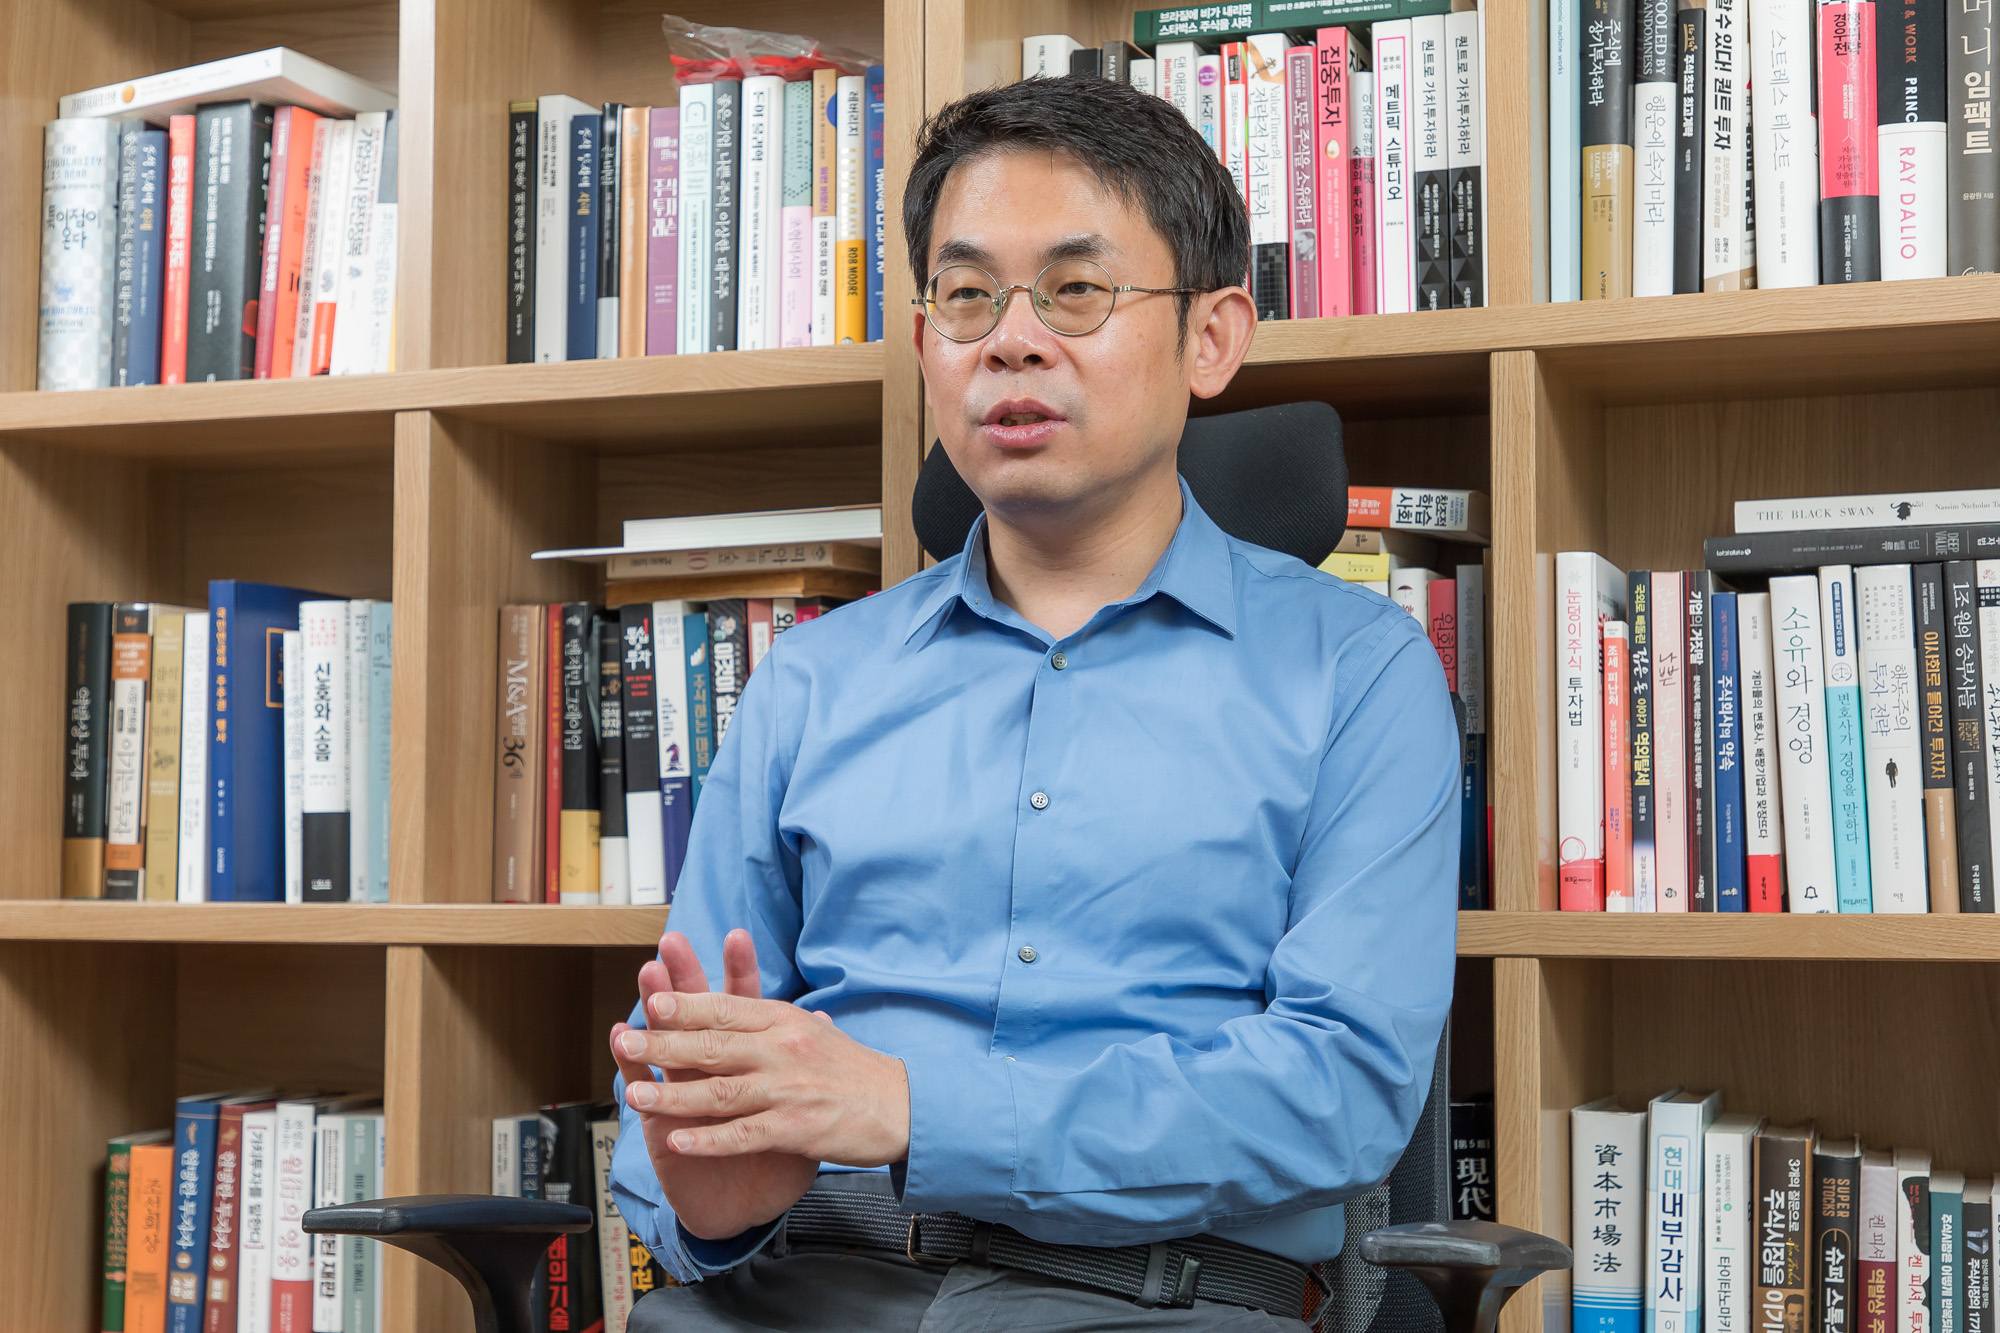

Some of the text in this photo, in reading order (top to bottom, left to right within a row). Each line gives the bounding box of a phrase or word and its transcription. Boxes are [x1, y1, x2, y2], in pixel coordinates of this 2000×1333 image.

[1158, 3, 1253, 24] 브라질에 비가 내리면
[1158, 16, 1253, 36] 스타벅스 주식을 사라
[1557, 24, 1565, 75] machine works
[1587, 19, 1605, 107] 장기투자하라
[1603, 19, 1622, 66] 주식에
[1655, 58, 1666, 76] BY
[1320, 45, 1342, 127] 집중투자
[1422, 39, 1438, 159] 퀀트로 가치투자하라
[1455, 35, 1471, 155] 퀀트로 가치투자하라
[1683, 54, 1695, 94] 주식초보
[1713, 13, 1732, 151] 수 있다! 퀀트 투자
[1769, 29, 1792, 172] 스트레스 테스트
[1904, 23, 1919, 123] WORK PRINC
[847, 91, 859, 137] 레버리지
[1644, 94, 1666, 149] 행운에
[1962, 70, 1993, 155] 임팩트
[1248, 86, 1272, 219] 전략적 가치 투자
[1292, 100, 1315, 226] 모든 주식을 소유하라
[1385, 84, 1403, 201] 메트릭 스튜디오
[1592, 152, 1601, 188] LONG RUN
[1604, 151, 1613, 180] STOCKS
[653, 178, 678, 198] 주식
[714, 93, 733, 301] 좋은 기업, 나쁜 주식, 이상한 대주주
[1898, 147, 1918, 260] RAY DALIO
[1963, 191, 1995, 201] 윤광원 지음
[48, 204, 102, 229] 특이점이
[62, 228, 88, 251] 온다
[118, 130, 138, 326] 좋은 나쁜 이상한 대주주
[1353, 213, 1364, 237] 일기
[818, 259, 828, 277] 투자
[847, 247, 859, 297] ROB MOORE
[1395, 493, 1413, 524] 사회
[1414, 493, 1433, 526] 학습
[1435, 494, 1448, 527] 창조적
[1756, 506, 1875, 521] THE BLACK SWAN
[1934, 501, 1991, 510] Nassim Nicholas
[1935, 530, 1948, 556] VALUE
[1946, 532, 1959, 553] DEEP
[1888, 584, 1898, 641] HEDGING
[1896, 584, 1906, 640] EXTREME VALUE
[1921, 598, 1930, 625] BOARDROOM
[1928, 582, 1936, 610] BARBARIANS
[1687, 590, 1705, 667] 기업의 거짓말
[1951, 581, 1978, 710] 1조 원의 승부사들
[625, 650, 653, 671] 투자
[713, 641, 736, 693] 이것이
[1565, 588, 1583, 727] 눈덩이주식 투자법
[1606, 645, 1619, 706] 조세 피난처
[1633, 583, 1651, 787] 국외로 빼돌린 이야기 역외탈세
[1780, 605, 1813, 765] 소유와 경영
[1867, 661, 1889, 697] 투자
[70, 686, 92, 741] 역발상
[313, 662, 332, 762] 신호와 소음
[505, 657, 530, 718] M&A
[563, 638, 583, 751] 벤저민 그레이엄
[1889, 663, 1912, 732] 행동주의
[1922, 630, 1947, 781] 이사회로 들어간 투자자
[693, 673, 709, 768] 주식하는 마음
[1716, 674, 1735, 771] 주식회사의 약속
[1868, 701, 1891, 737] 전략
[70, 741, 91, 781] 투자
[1751, 669, 1769, 839] 개미들의 변호사, 배짱기업과 맞장뜨다
[1837, 691, 1859, 845] 변호사가 경영을 말하다
[112, 738, 137, 836] 이기는 투자
[175, 1147, 201, 1250] 현명한 투자자
[211, 1150, 237, 1251] 현명한 투자자
[247, 1130, 265, 1245] 가치투자를 말한다
[1456, 1157, 1492, 1216] 現代
[1593, 1144, 1624, 1274] 資本市場法
[1786, 1158, 1801, 1233] 3개의 질문으로
[1822, 1177, 1837, 1218] STOCKS
[1837, 1177, 1851, 1219] SUPER
[277, 1228, 301, 1273] 영웅
[352, 1173, 365, 1294] BIG SMALL
[1658, 1191, 1685, 1303] 내부감사
[1762, 1188, 1786, 1287] 주식시장을
[1868, 1214, 1886, 1260] 켄 피셔
[1940, 1213, 1954, 1296] 주식시장은 어떻게
[1966, 1227, 1989, 1255] 17
[319, 1260, 337, 1300] 재판
[1824, 1246, 1846, 1284] 슈퍼
[1867, 1268, 1886, 1316] 역발상
[1906, 1254, 1923, 1305] 켄 피셔,
[1966, 1257, 1981, 1309] 주식시장의
[1981, 1258, 1989, 1275] 당신의
[550, 1284, 570, 1331] 기술
